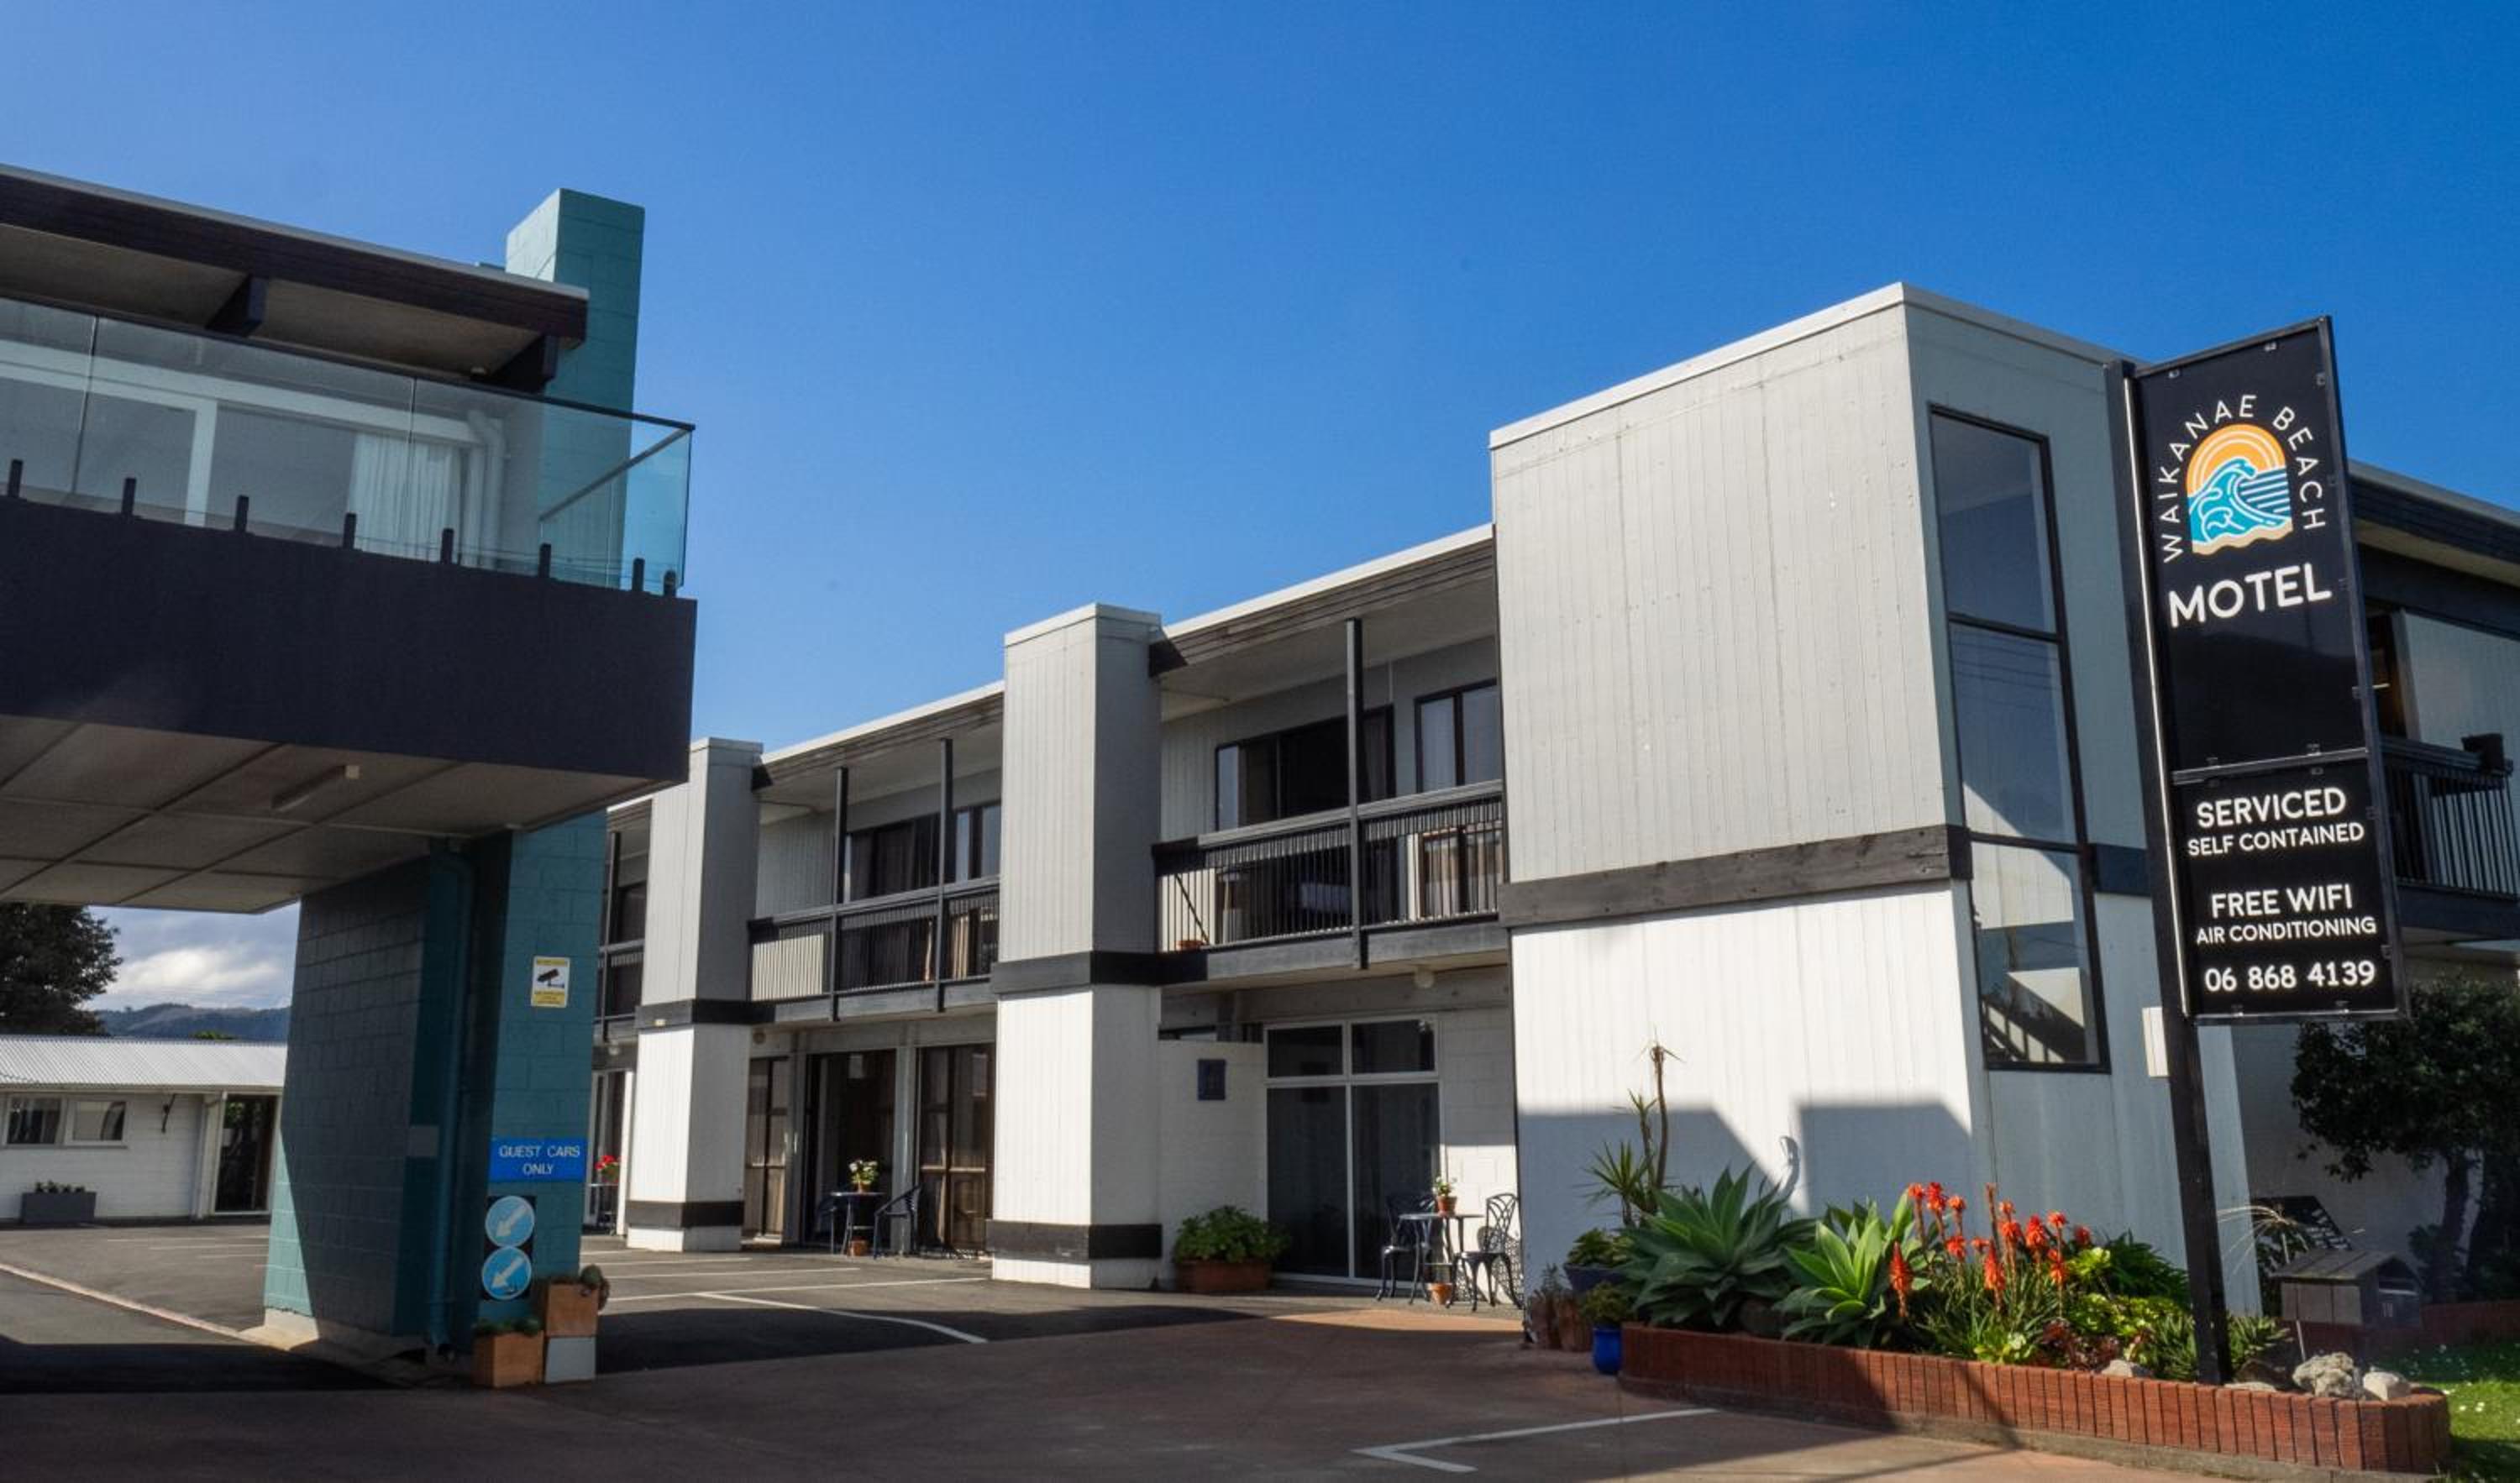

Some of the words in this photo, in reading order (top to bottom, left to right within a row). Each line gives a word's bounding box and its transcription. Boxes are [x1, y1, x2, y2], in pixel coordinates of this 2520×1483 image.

[2158, 395, 2257, 563] WAIKANAE
[2272, 406, 2326, 530] BEACH
[2168, 563, 2333, 628] MOTEL
[2197, 787, 2346, 828] SERVICED
[2187, 835, 2234, 856] SELF
[2239, 822, 2365, 852] CONTAINED
[2211, 889, 2281, 919] FREE
[2286, 883, 2352, 913] WIFI
[2196, 925, 2226, 945] AIR
[2229, 916, 2377, 942] CONDITIONING
[2204, 967, 2238, 992] 06
[2247, 965, 2297, 990] 868
[2307, 960, 2376, 987] 4139
[499, 1145, 541, 1158] GUEST
[546, 1145, 580, 1158] CARS
[522, 1162, 553, 1176] ONLY
